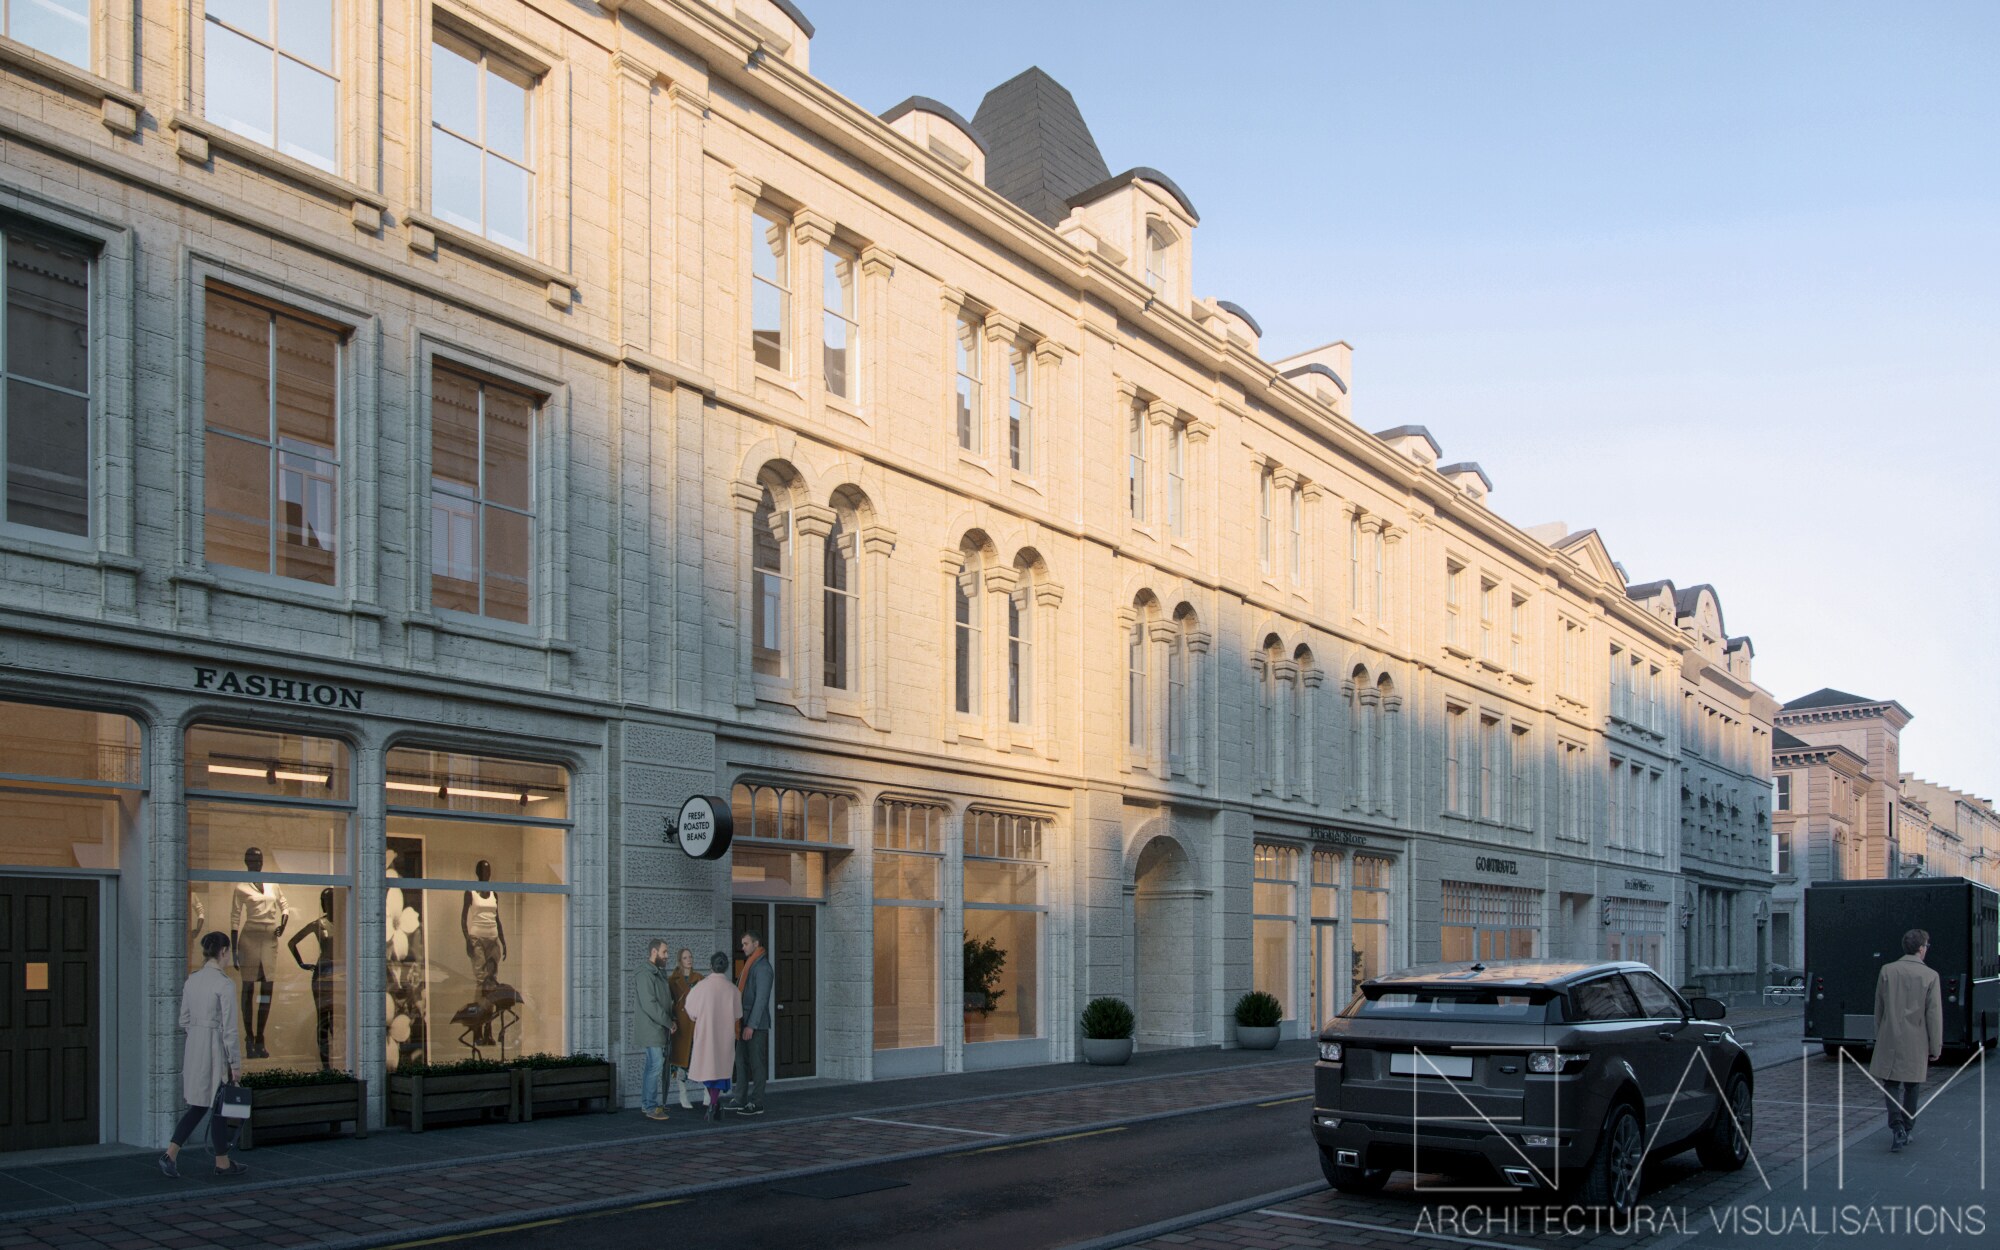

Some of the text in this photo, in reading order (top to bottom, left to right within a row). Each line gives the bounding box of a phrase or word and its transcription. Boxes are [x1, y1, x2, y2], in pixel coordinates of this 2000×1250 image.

[194, 667, 364, 709] FASHION
[687, 811, 706, 820] FRESH
[683, 821, 710, 831] ROASTED
[686, 832, 707, 841] BEANS
